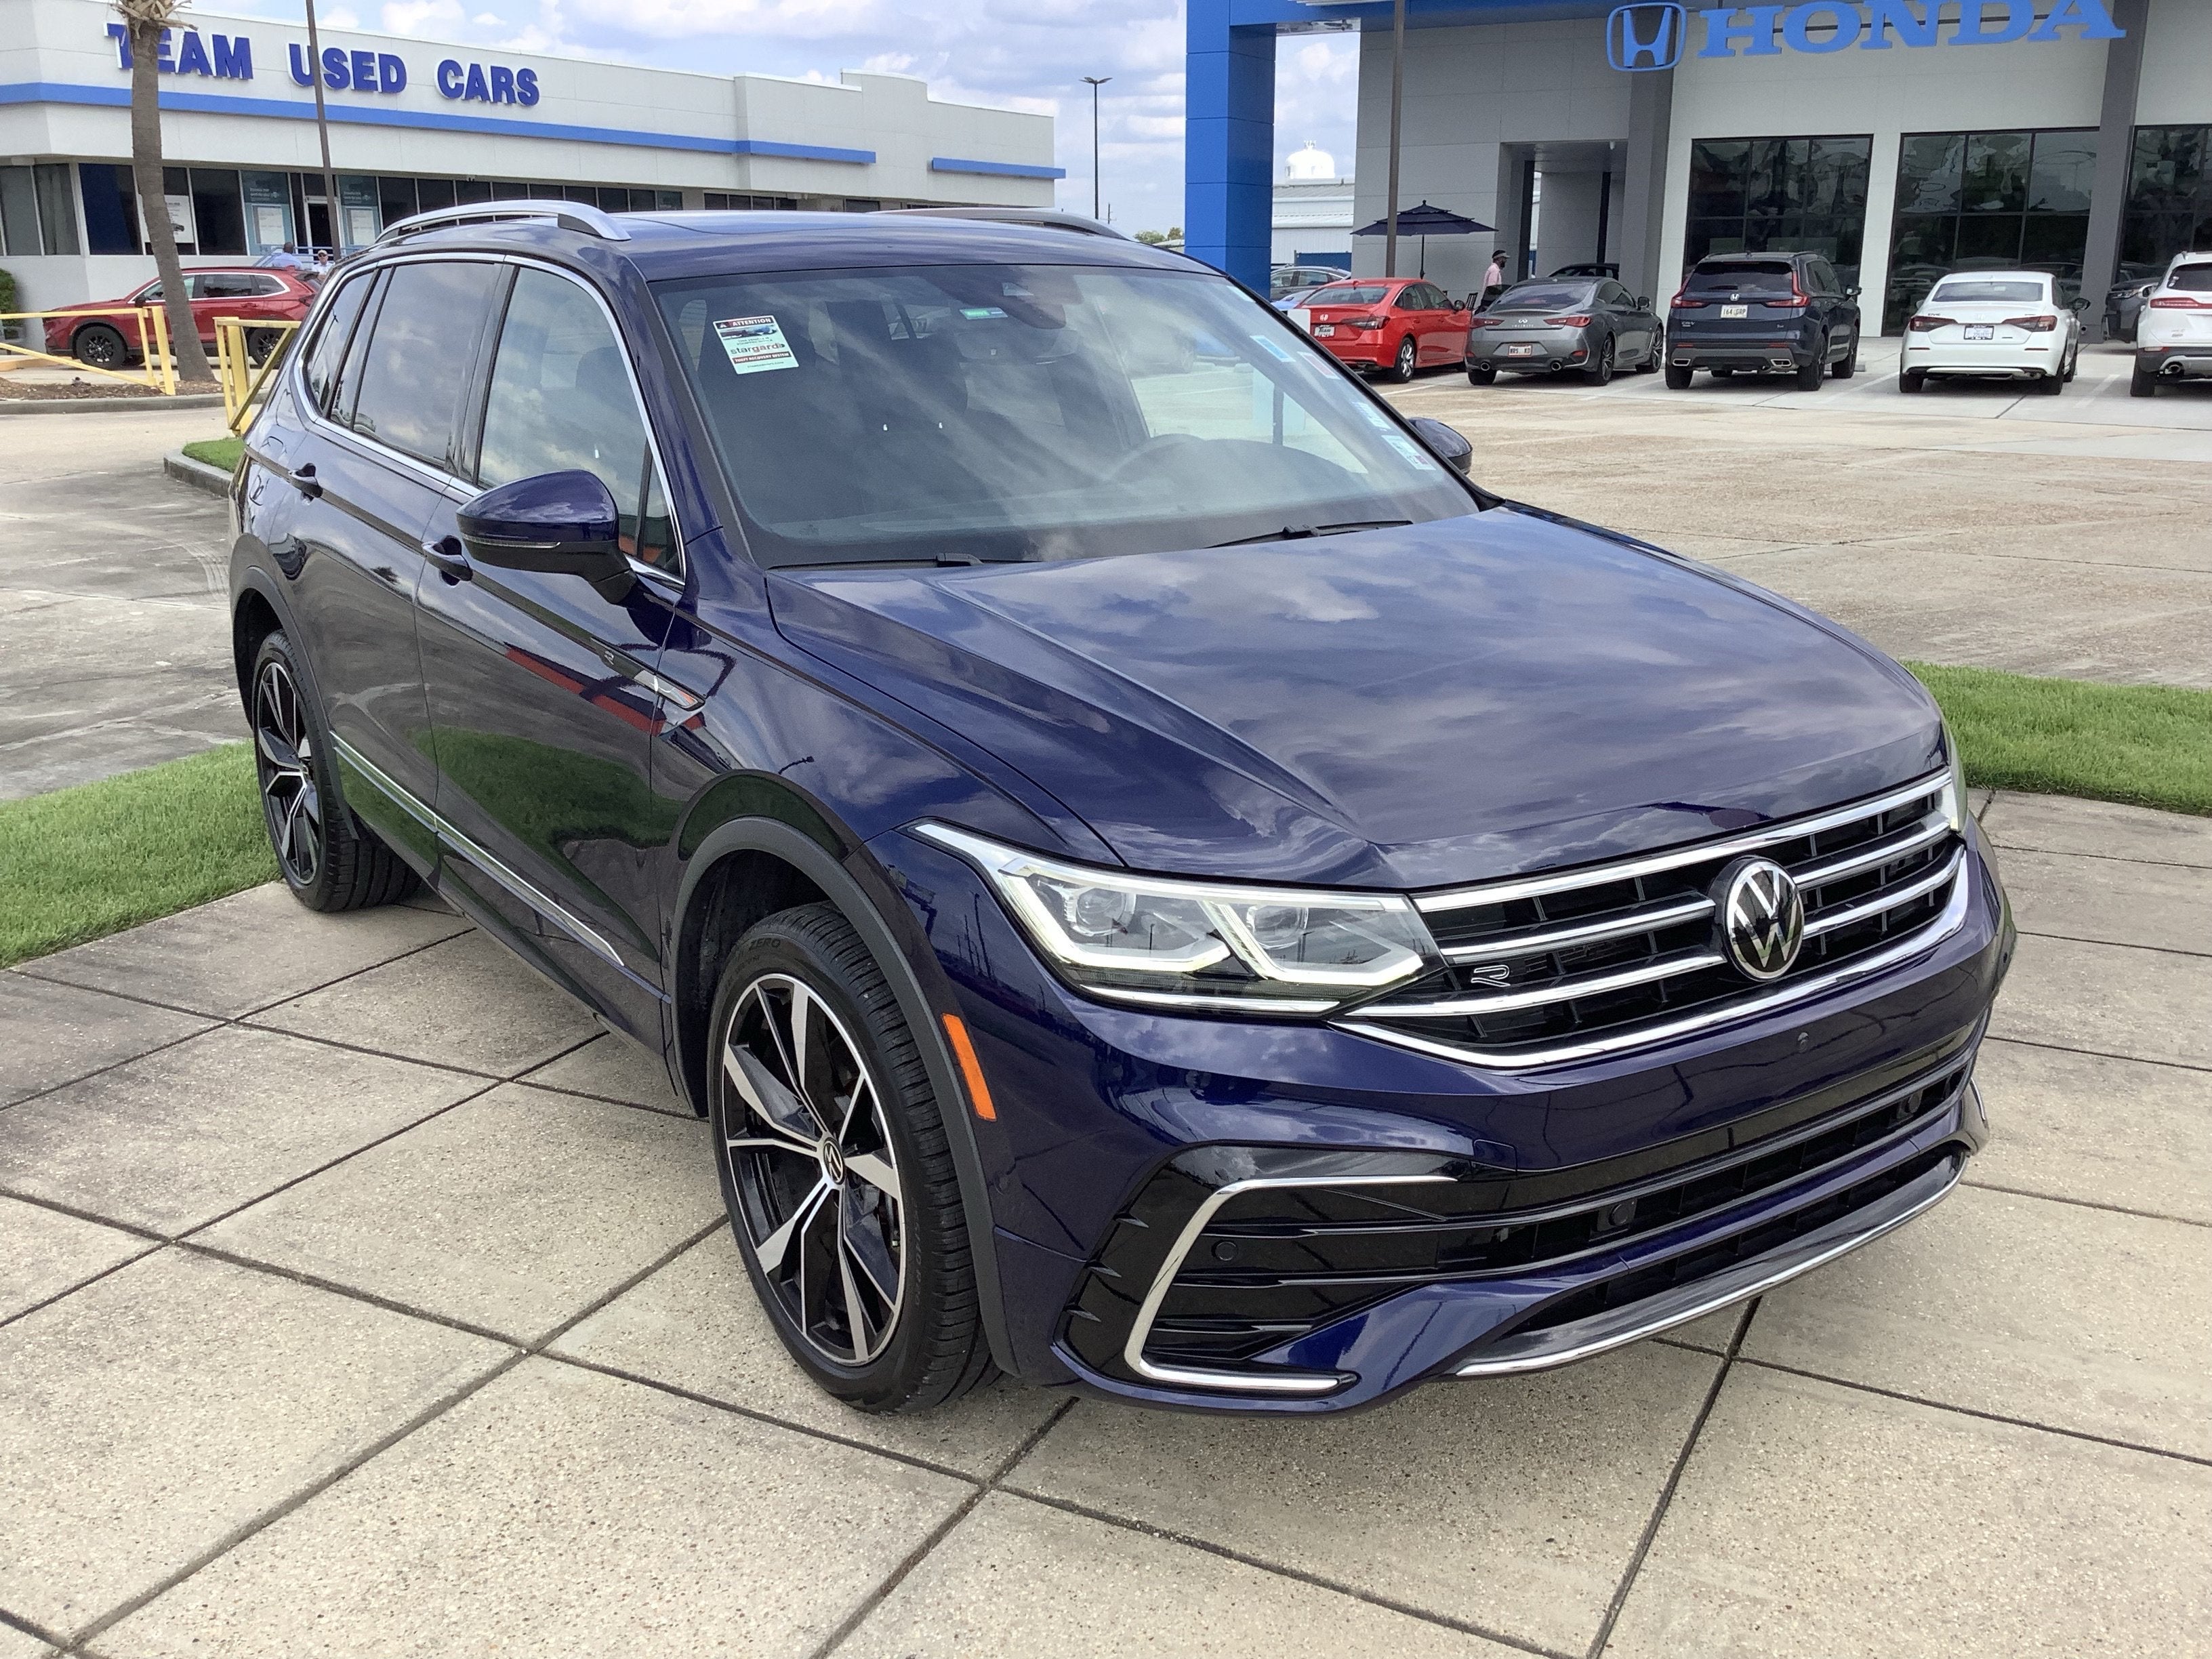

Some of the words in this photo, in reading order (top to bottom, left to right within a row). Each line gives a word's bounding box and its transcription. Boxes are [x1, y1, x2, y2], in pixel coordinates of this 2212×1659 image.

[1697, 0, 2128, 59] HONDA
[287, 43, 407, 94] USED
[435, 58, 541, 107] CARS
[733, 318, 771, 326] ATTENTION
[748, 937, 781, 952] ZERO
